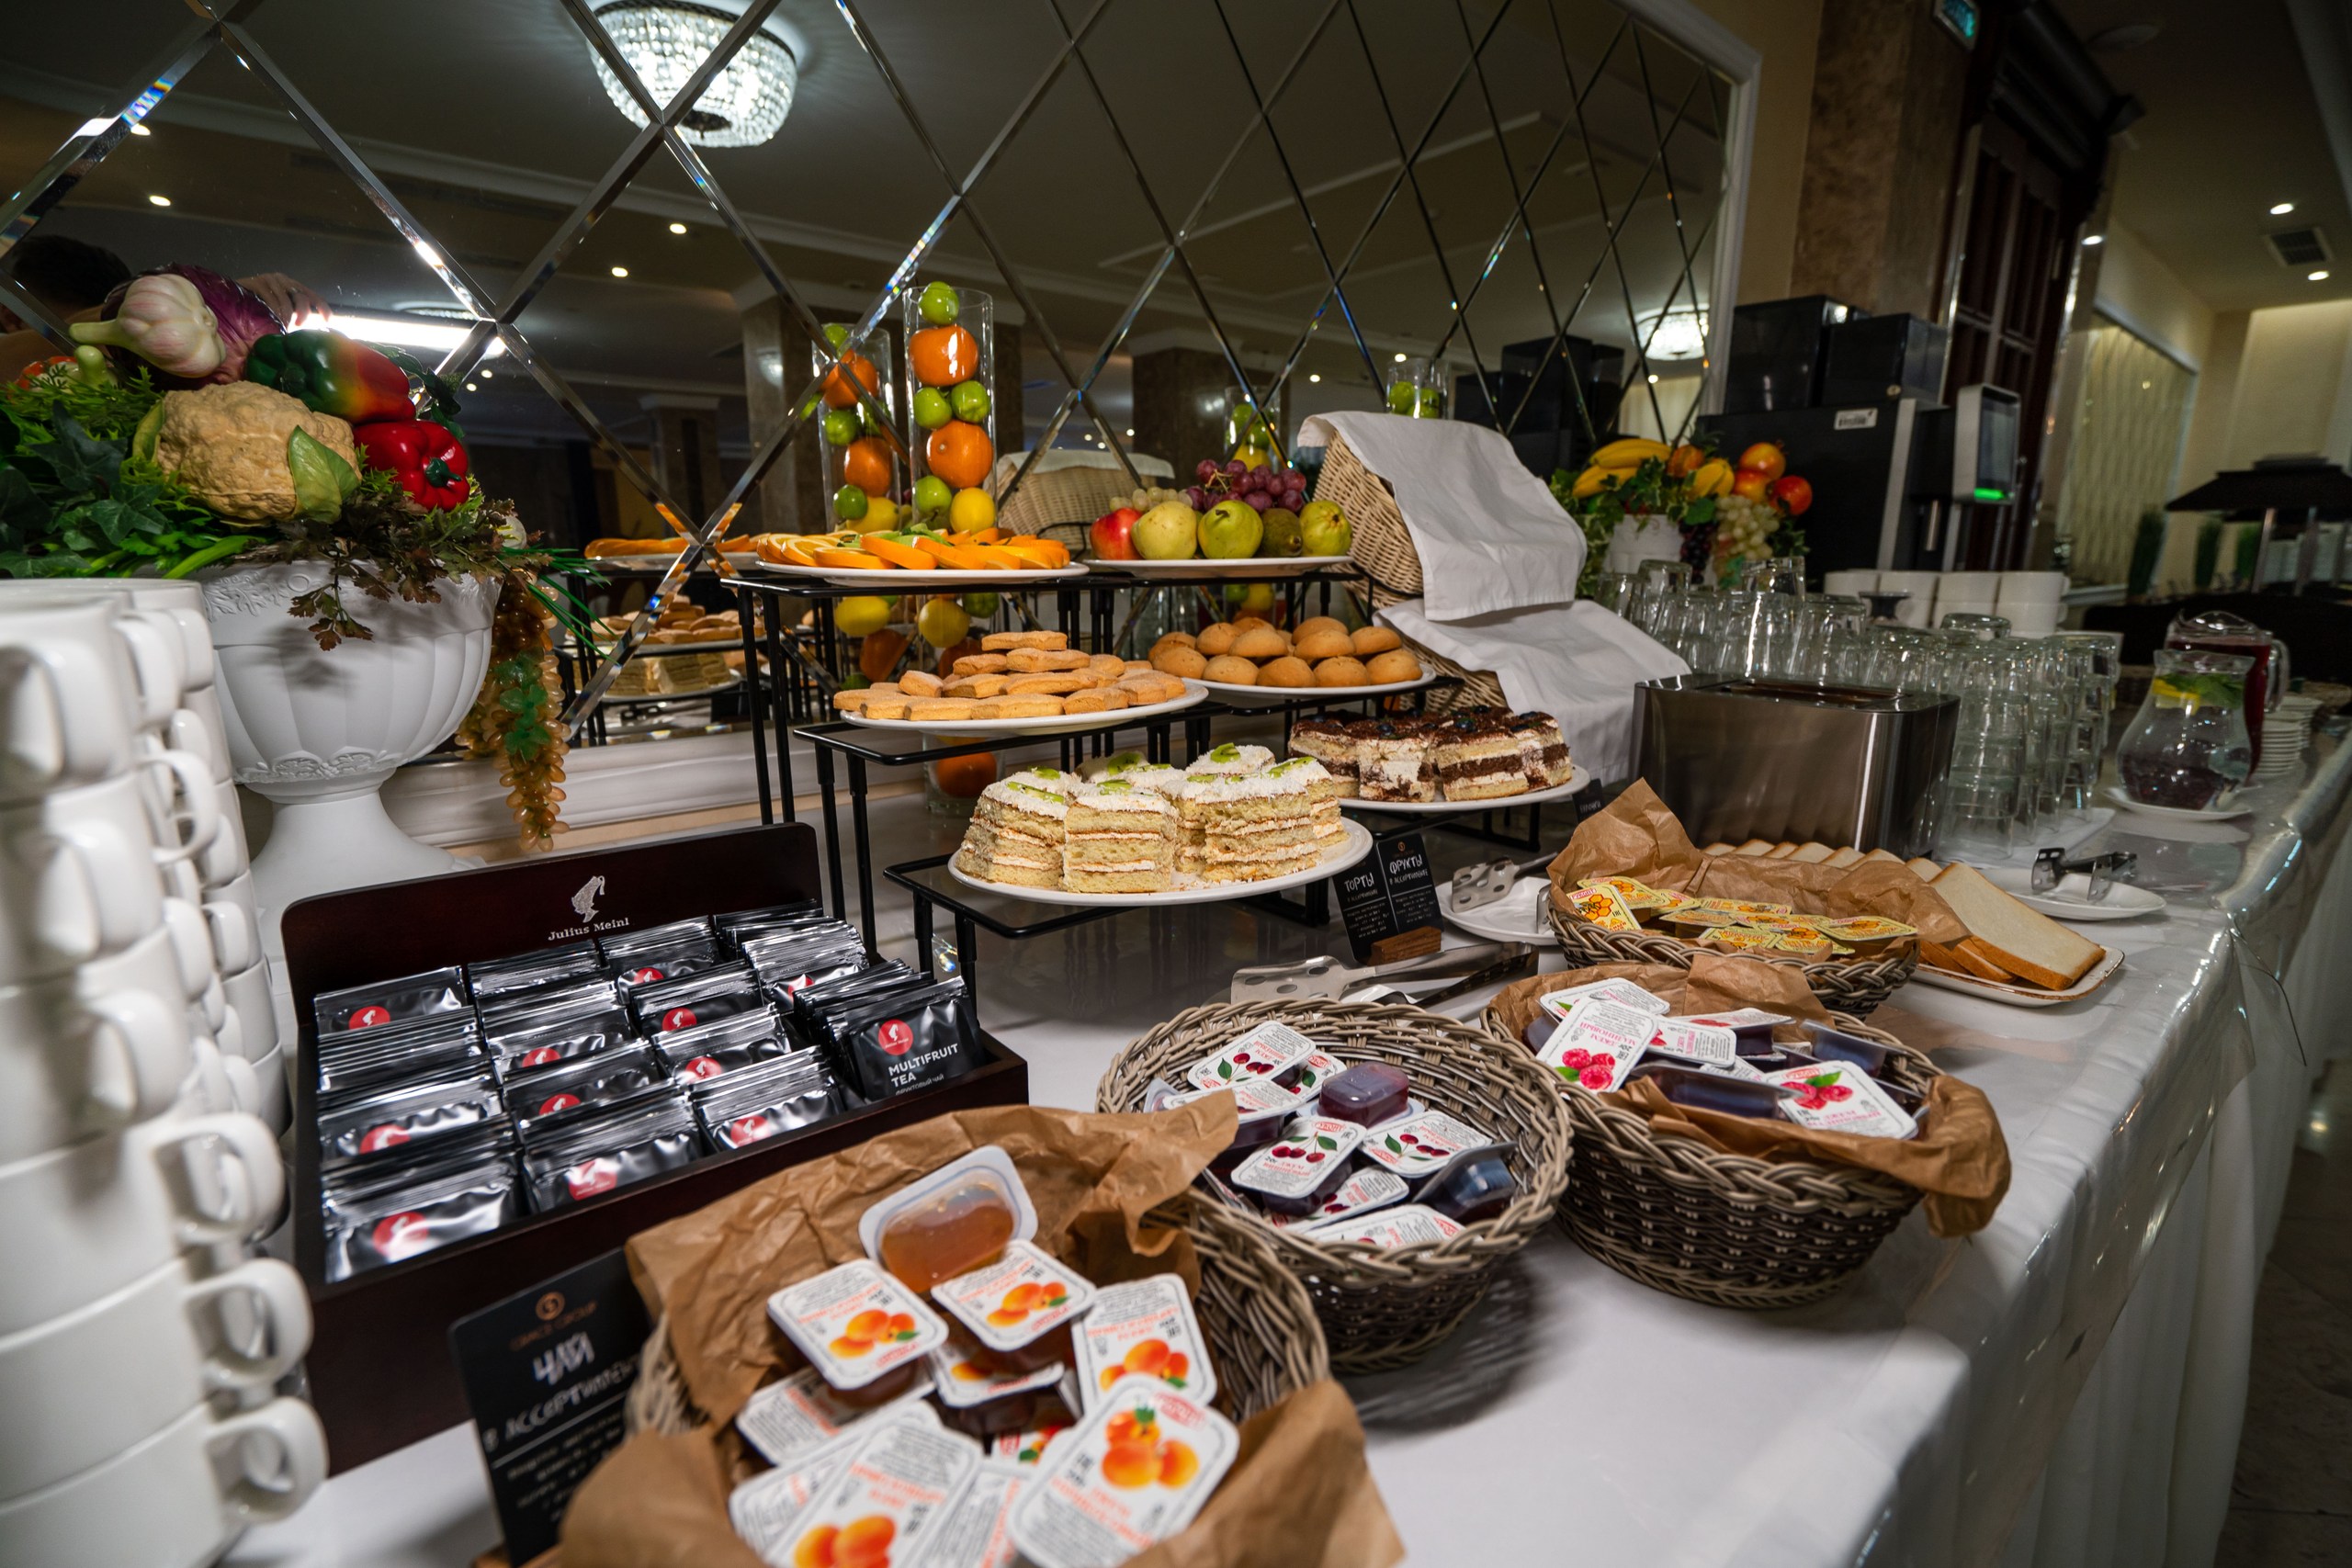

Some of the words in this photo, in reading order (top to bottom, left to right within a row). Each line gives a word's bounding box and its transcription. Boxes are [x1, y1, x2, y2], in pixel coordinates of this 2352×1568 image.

[1389, 854, 1423, 874] ФРУКТЫ
[1344, 873, 1374, 893] ТОРТЫ
[548, 926, 590, 941] Julius
[594, 918, 630, 931] Meinl
[1579, 1021, 1636, 1045] МАЛИНОВЫЙ
[1590, 1033, 1616, 1046] ДЖЕМ
[888, 1043, 958, 1076] MULTIFRUIT
[891, 1072, 916, 1088] TEA
